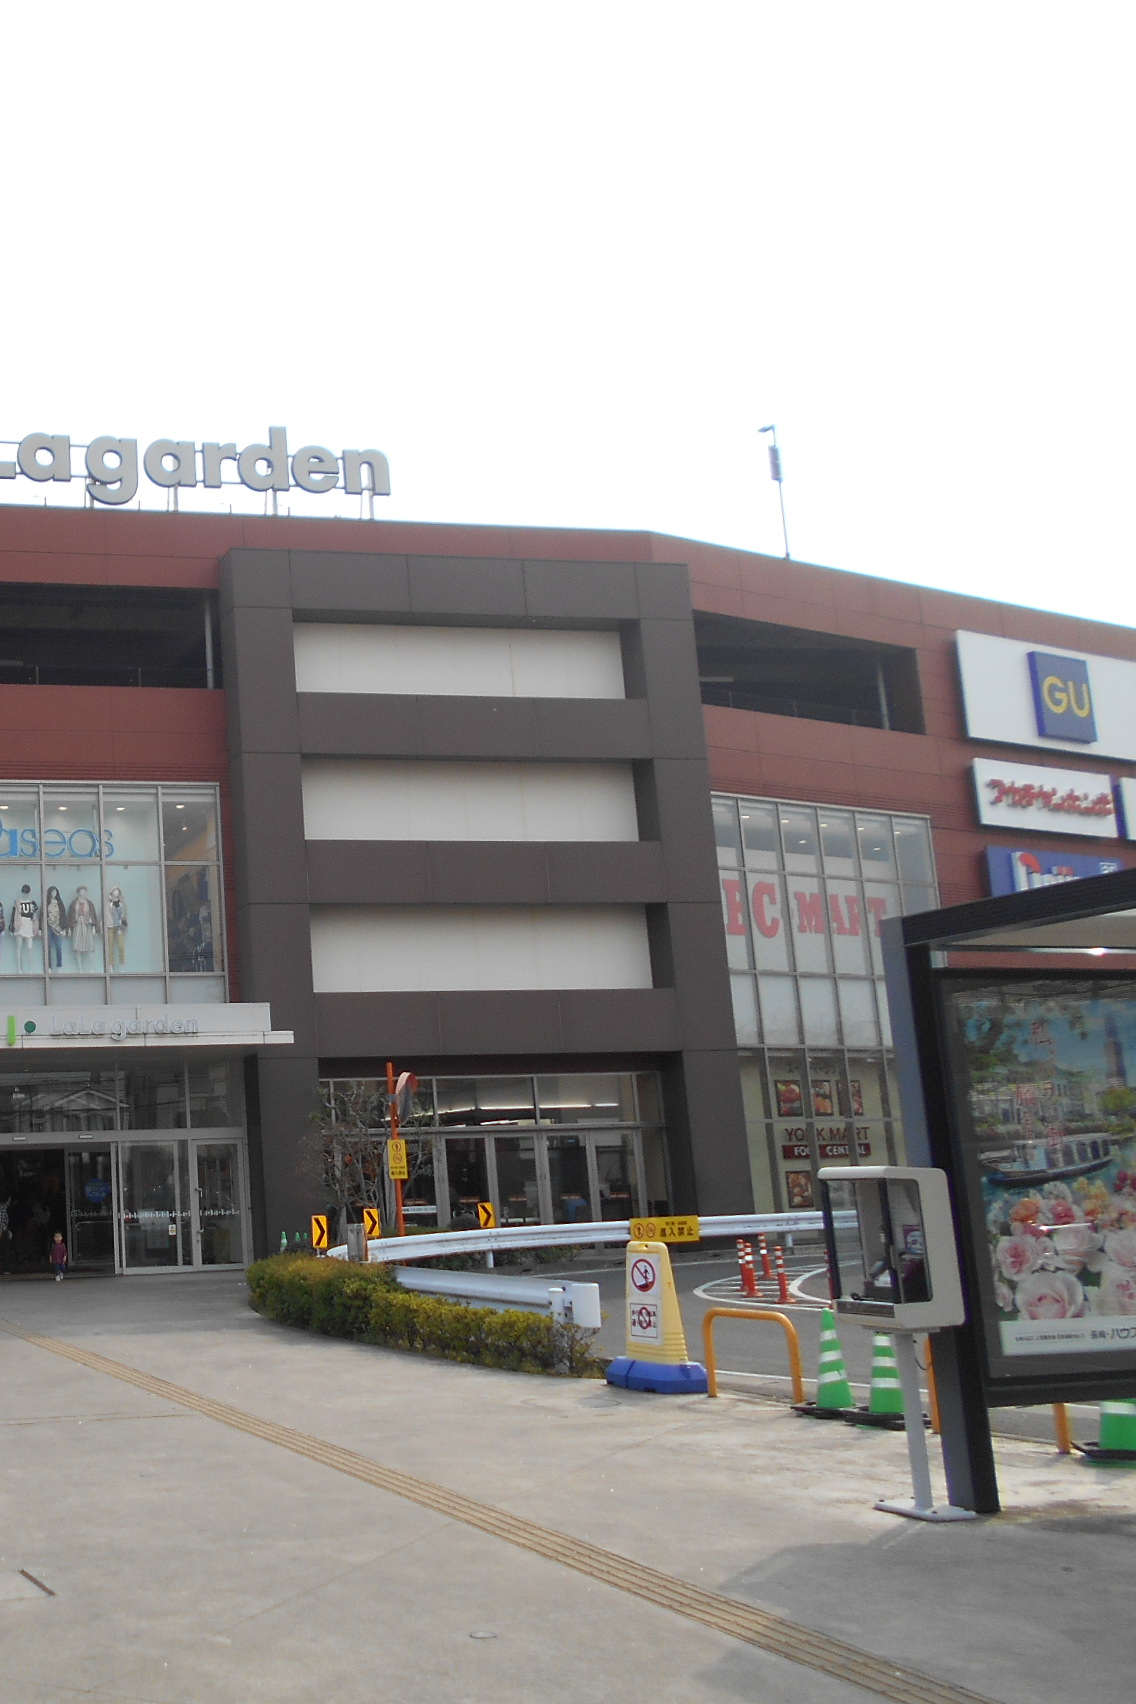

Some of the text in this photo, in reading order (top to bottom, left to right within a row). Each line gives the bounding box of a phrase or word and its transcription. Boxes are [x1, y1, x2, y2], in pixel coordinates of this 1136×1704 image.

[1043, 676, 1090, 717] GU
[51, 1014, 199, 1041] LaLa garden
[785, 1127, 825, 1141] YOK
